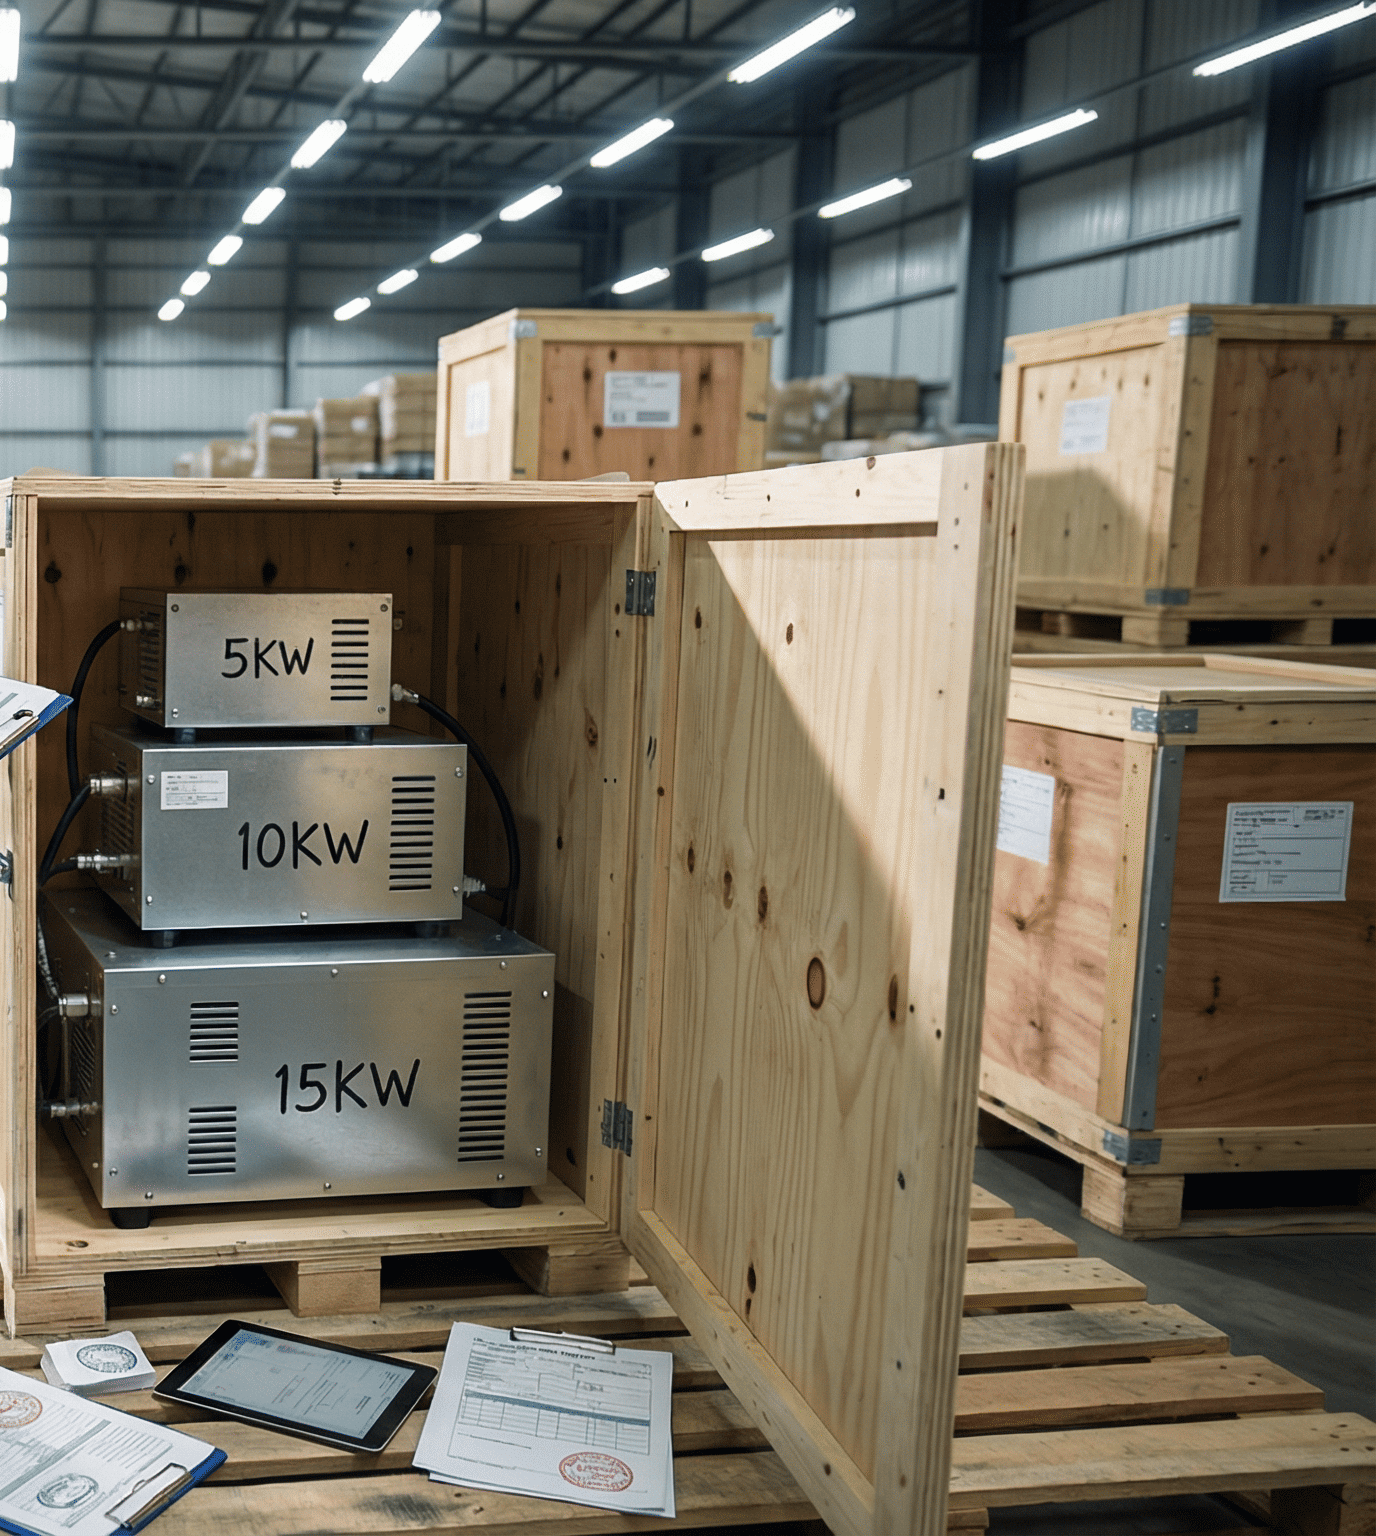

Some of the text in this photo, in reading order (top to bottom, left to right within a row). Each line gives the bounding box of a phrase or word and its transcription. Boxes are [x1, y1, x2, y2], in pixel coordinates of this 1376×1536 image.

[221, 637, 314, 679] 5KW
[238, 819, 369, 871] 10KW
[275, 1058, 421, 1115] 15KW
